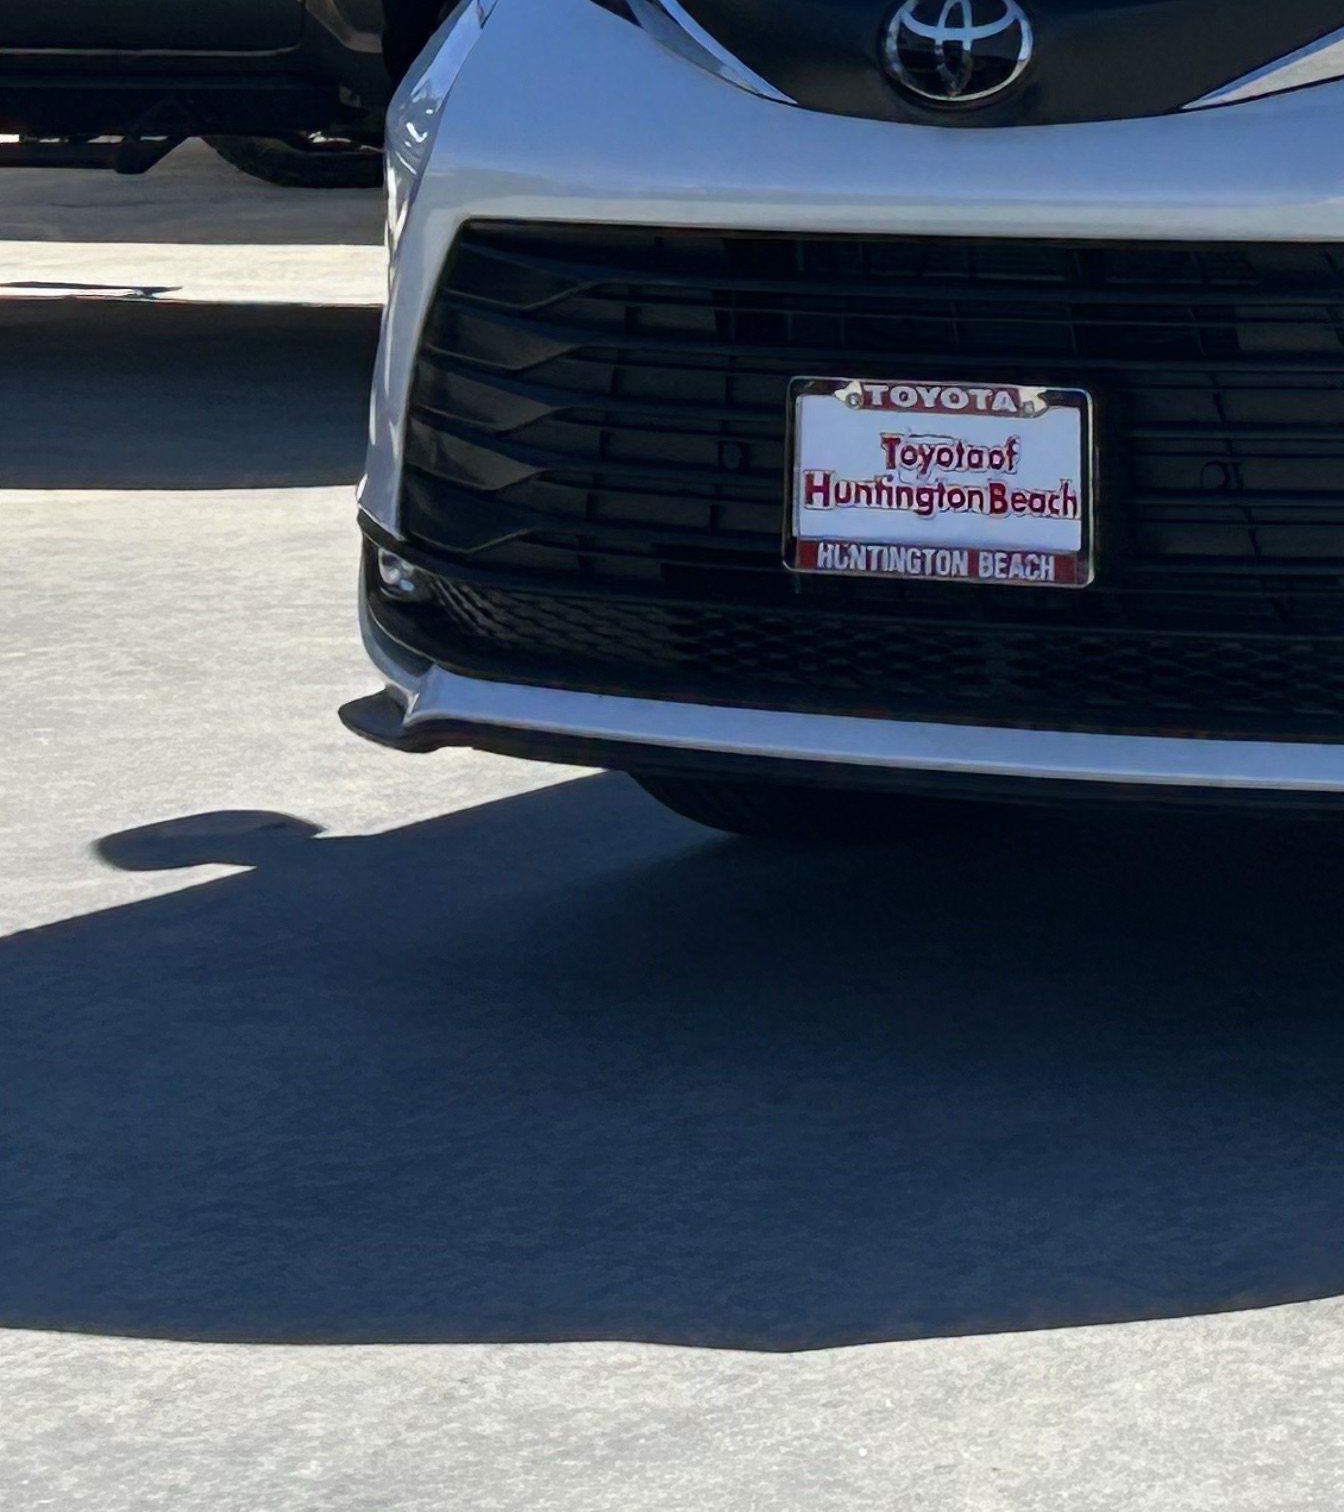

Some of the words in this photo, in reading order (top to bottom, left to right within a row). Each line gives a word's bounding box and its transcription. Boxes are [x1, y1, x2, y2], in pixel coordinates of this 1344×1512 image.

[863, 385, 1018, 413] TOYOTA
[880, 434, 984, 475] Toyota
[803, 471, 985, 517] Huntington
[987, 479, 1080, 518] Beach
[816, 541, 969, 578] HUNTINGTON
[977, 551, 1056, 582] BEACH
